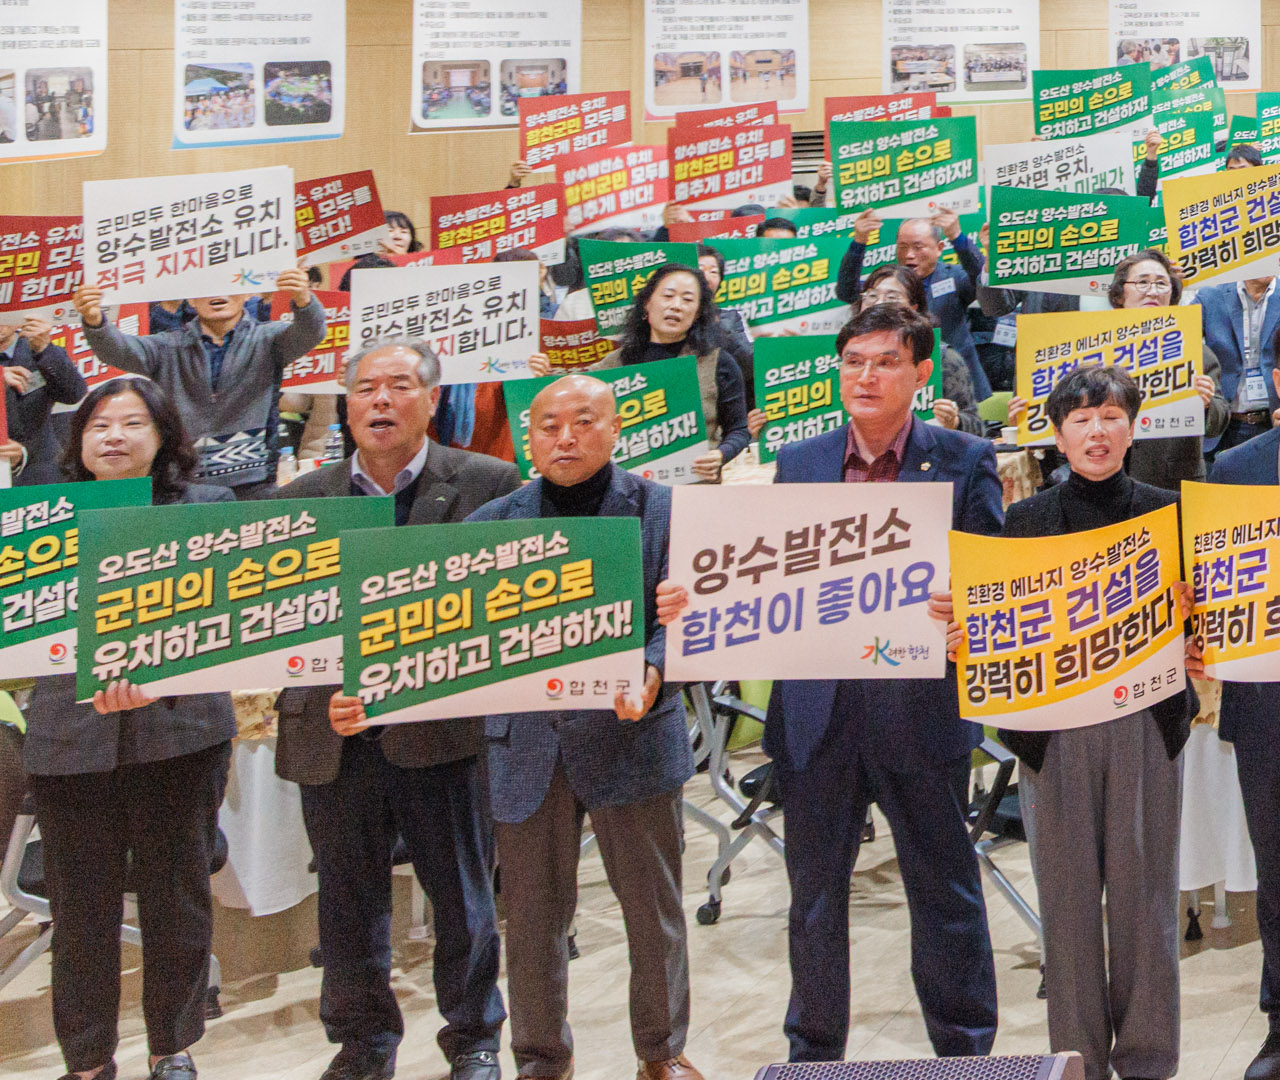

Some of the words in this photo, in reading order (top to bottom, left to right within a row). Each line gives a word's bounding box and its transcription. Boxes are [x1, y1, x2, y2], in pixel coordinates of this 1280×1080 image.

[838, 140, 873, 159] 오도산
[876, 125, 938, 151] 양수발전소
[839, 154, 890, 185] 군민의
[897, 139, 951, 172] 손으로
[97, 206, 163, 236] 군민모두
[171, 184, 252, 218] 한마음으로
[841, 179, 900, 209] 유치하고
[904, 159, 972, 195] 건설하자!
[1179, 200, 1209, 220] 친환경
[1213, 187, 1243, 208] 에너지
[97, 214, 223, 264] 양수발전소
[233, 197, 281, 230] 유치
[97, 261, 145, 291] 적극
[156, 227, 288, 278] 지지합니다.
[1179, 206, 1239, 249] 합천군
[1179, 237, 1237, 278] 강력히
[97, 540, 180, 583] 오도산
[186, 511, 317, 561] 양수발전소
[360, 561, 438, 605] 오도산
[445, 530, 569, 582] 양수발전소
[692, 508, 912, 595] 양수발전소
[967, 582, 1004, 606] 친환경
[1010, 566, 1063, 599] 에너지
[1070, 527, 1150, 580] 양수발전소
[95, 568, 214, 634] 군민의
[227, 537, 340, 599] 손으로
[359, 588, 472, 657] 군민의
[485, 558, 594, 622] 손으로
[681, 587, 804, 657] 합천이
[816, 561, 936, 625] 좋아요
[966, 598, 1052, 653] 합천군
[1067, 548, 1159, 631] 건설을
[92, 613, 231, 680] 유치하고
[358, 635, 491, 705] 유치하고
[498, 600, 633, 666] 건설하자!
[966, 653, 1043, 703] 강력히
[1054, 587, 1174, 687] 희망한다
